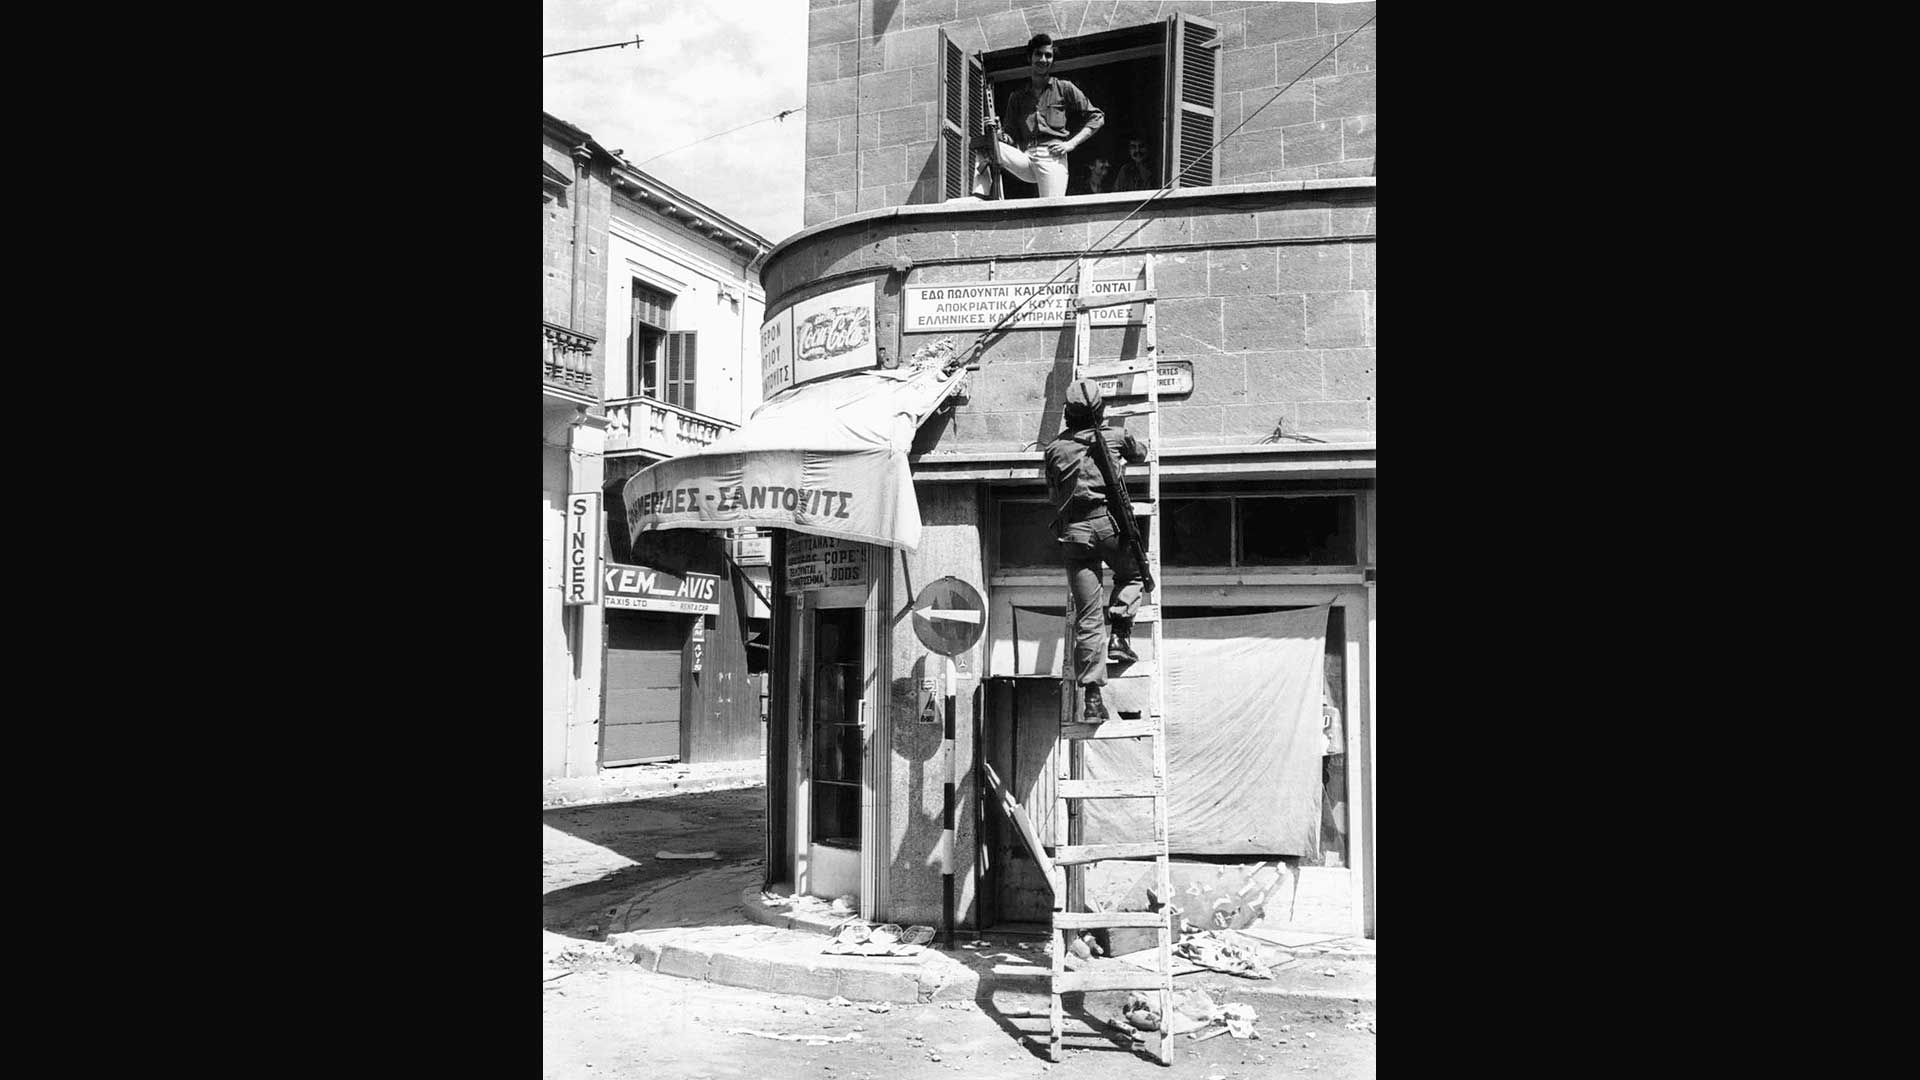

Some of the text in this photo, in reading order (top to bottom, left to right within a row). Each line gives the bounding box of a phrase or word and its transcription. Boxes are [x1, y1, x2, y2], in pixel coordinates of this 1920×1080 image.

[921, 282, 1131, 300] ΕΔΩ ΠΩΛΟΥΝΤΑΙ ΚΑΙ ΕΝΟΙΚΙΟΝΤΑΙ
[936, 299, 1017, 313] ΑΠΟΚΡΙΑΤΙΚΑ
[918, 313, 985, 325] ΕΛΛΗΝΙΚΕΣ
[1013, 310, 1078, 322] ΚΥΠΡΙΑΚΕΣ
[1091, 308, 1133, 319] ΤΟΛΕΣ
[717, 485, 853, 519] ΣΑΝΤΟΥΙΤΣ
[572, 499, 587, 600] SINGER
[605, 567, 715, 600] KEM AVIS
[605, 597, 648, 608] TAXIS LTD
